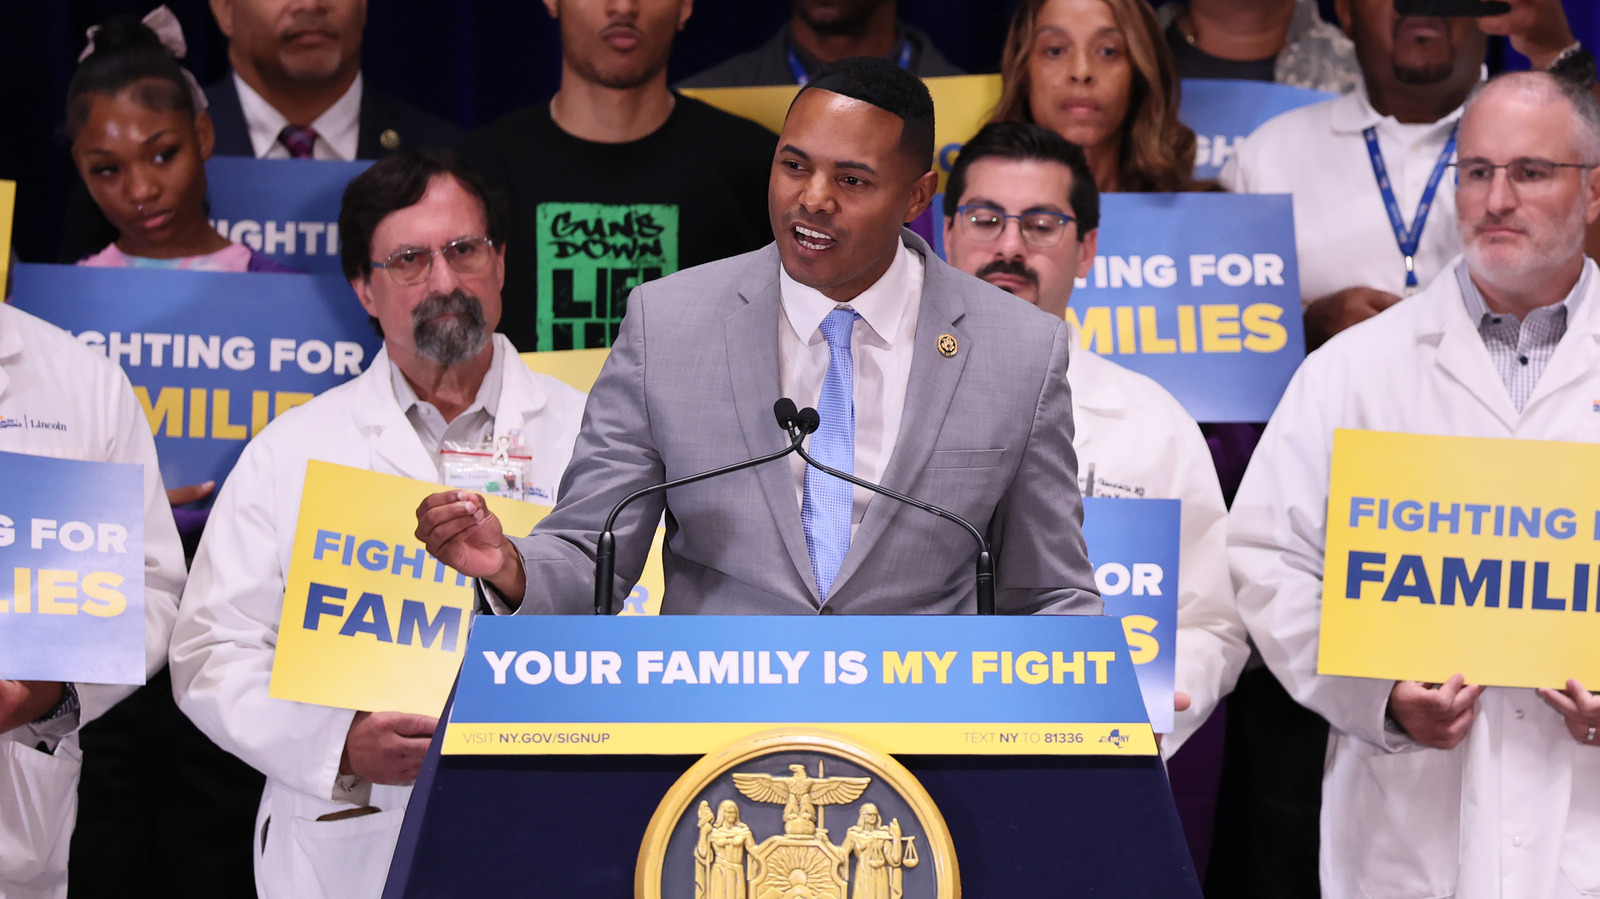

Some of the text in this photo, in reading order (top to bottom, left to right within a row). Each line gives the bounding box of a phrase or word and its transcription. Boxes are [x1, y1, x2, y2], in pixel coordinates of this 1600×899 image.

[552, 212, 664, 238] GUNS
[548, 238, 664, 260] DOWN
[1074, 253, 1285, 288] ING FOR
[1065, 303, 1288, 354] MILIES
[69, 330, 364, 375] GHTING FOR
[31, 420, 67, 431] Lincoln
[31, 518, 128, 553] FOR
[1349, 496, 1577, 540] FIGHTING
[0, 567, 126, 617] IES
[1092, 562, 1163, 596] OR
[1345, 550, 1600, 613] FAMILI
[303, 581, 474, 653] FAM
[482, 650, 1115, 685] YOUR FAMILY IS MY FIGHT
[463, 733, 494, 744] VISIT
[499, 732, 610, 744] NY.GOV/SIGNUP
[964, 733, 996, 743] TEXT
[1000, 733, 1018, 743] NY
[1024, 733, 1040, 743] TO
[1045, 732, 1083, 744] 81336
